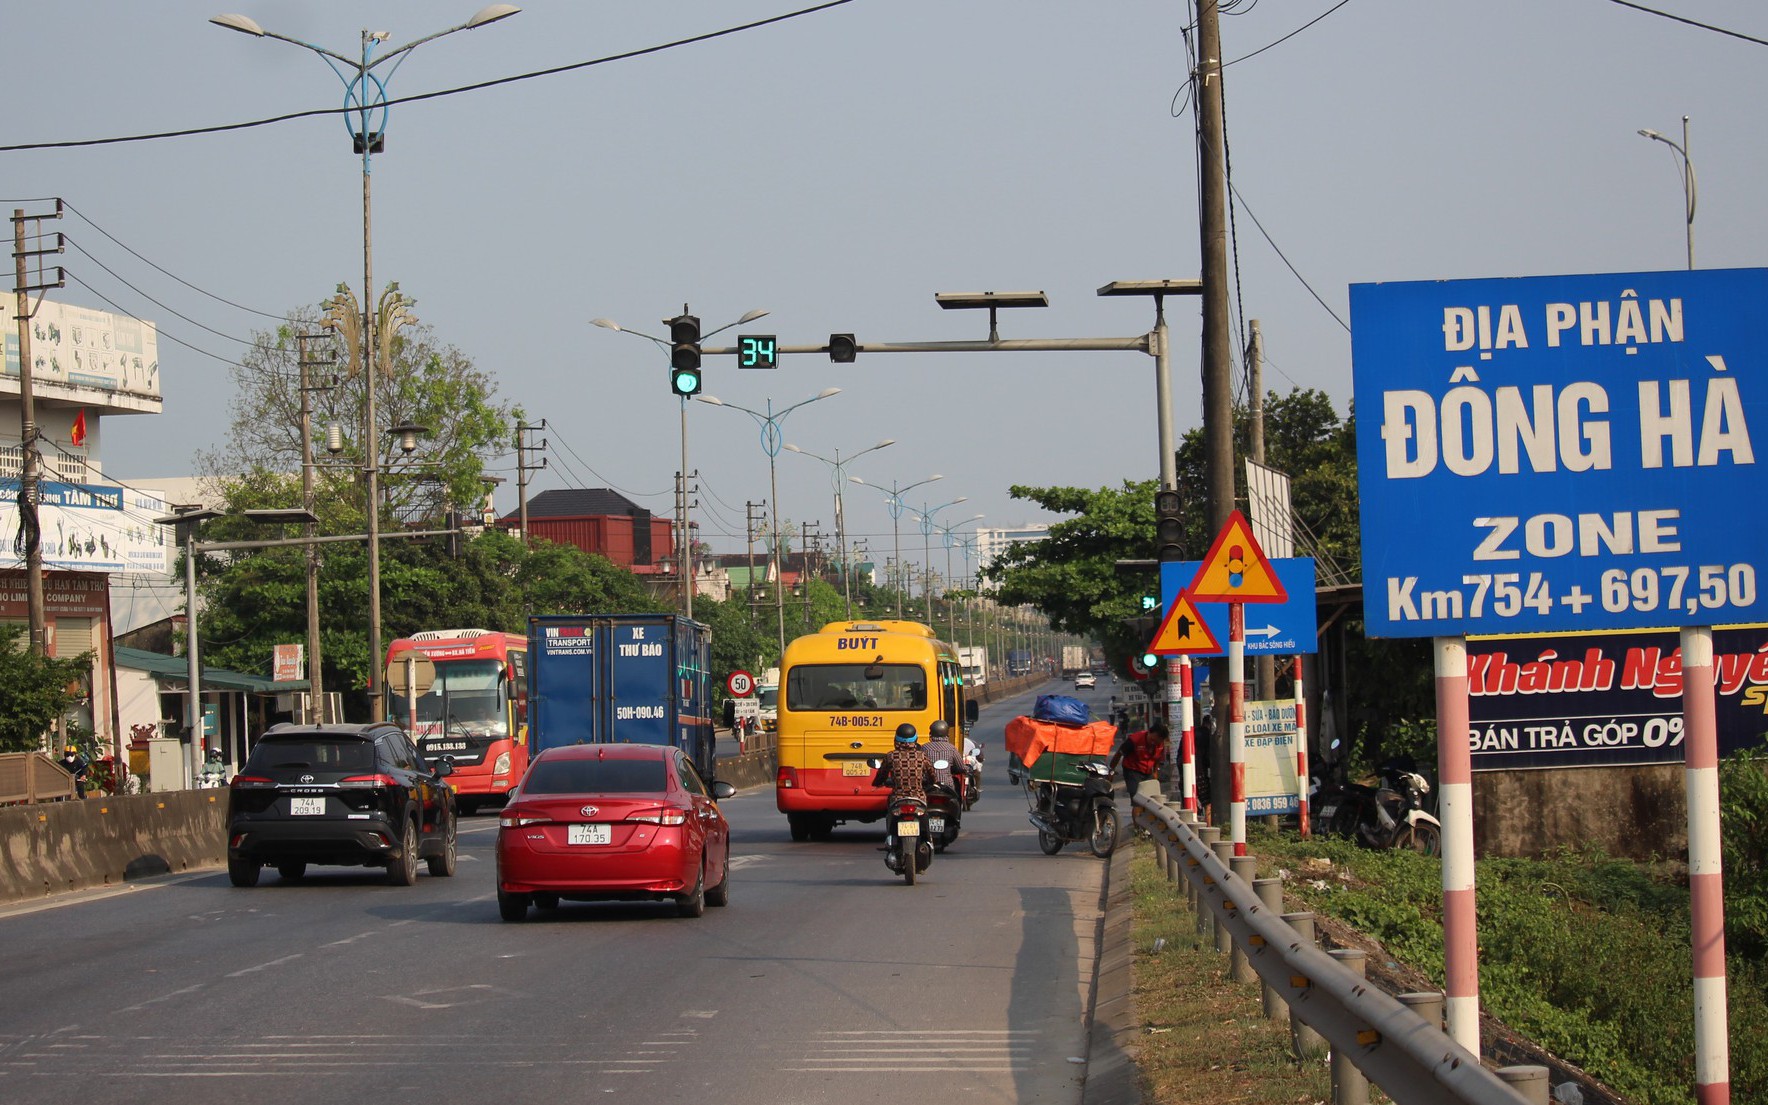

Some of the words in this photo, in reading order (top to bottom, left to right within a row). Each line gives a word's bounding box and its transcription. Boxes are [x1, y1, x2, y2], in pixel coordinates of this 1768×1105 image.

[1442, 304, 1529, 360] ĐỊA
[1545, 288, 1684, 355] PHẬN
[743, 338, 774, 366] 34
[1381, 366, 1612, 479] ĐÔNG
[1637, 355, 1755, 469] HÀ
[0, 488, 22, 500] CÔN
[63, 489, 91, 506] TÂM
[1472, 508, 1681, 560] ZONE
[10, 578, 29, 592] NHIỆ
[46, 593, 87, 603] COMPANY
[632, 627, 645, 640] XE
[548, 638, 592, 647] TRANSPORT
[619, 642, 641, 657] THƯ
[641, 641, 663, 657] BÁO
[837, 635, 879, 650] BUÝT
[1467, 647, 1615, 697] Khánh
[735, 678, 747, 690] 50
[617, 706, 664, 720] 50H-090.46
[1252, 706, 1264, 721] SỬA
[1281, 704, 1297, 719] DƯỠN
[829, 716, 883, 727] 74B-005.21
[1272, 722, 1283, 732] XE
[1469, 724, 1519, 751] BÁN
[1524, 720, 1577, 749] TRẢ
[1583, 719, 1639, 747] GÓP
[1244, 738, 1255, 748] XE
[1256, 737, 1273, 749] ĐẠP
[1274, 736, 1293, 747] ĐIỆN
[294, 806, 321, 814] 209.19
[1272, 796, 1288, 810] 959
[580, 824, 599, 834] 74A
[573, 833, 606, 843] 170.35
